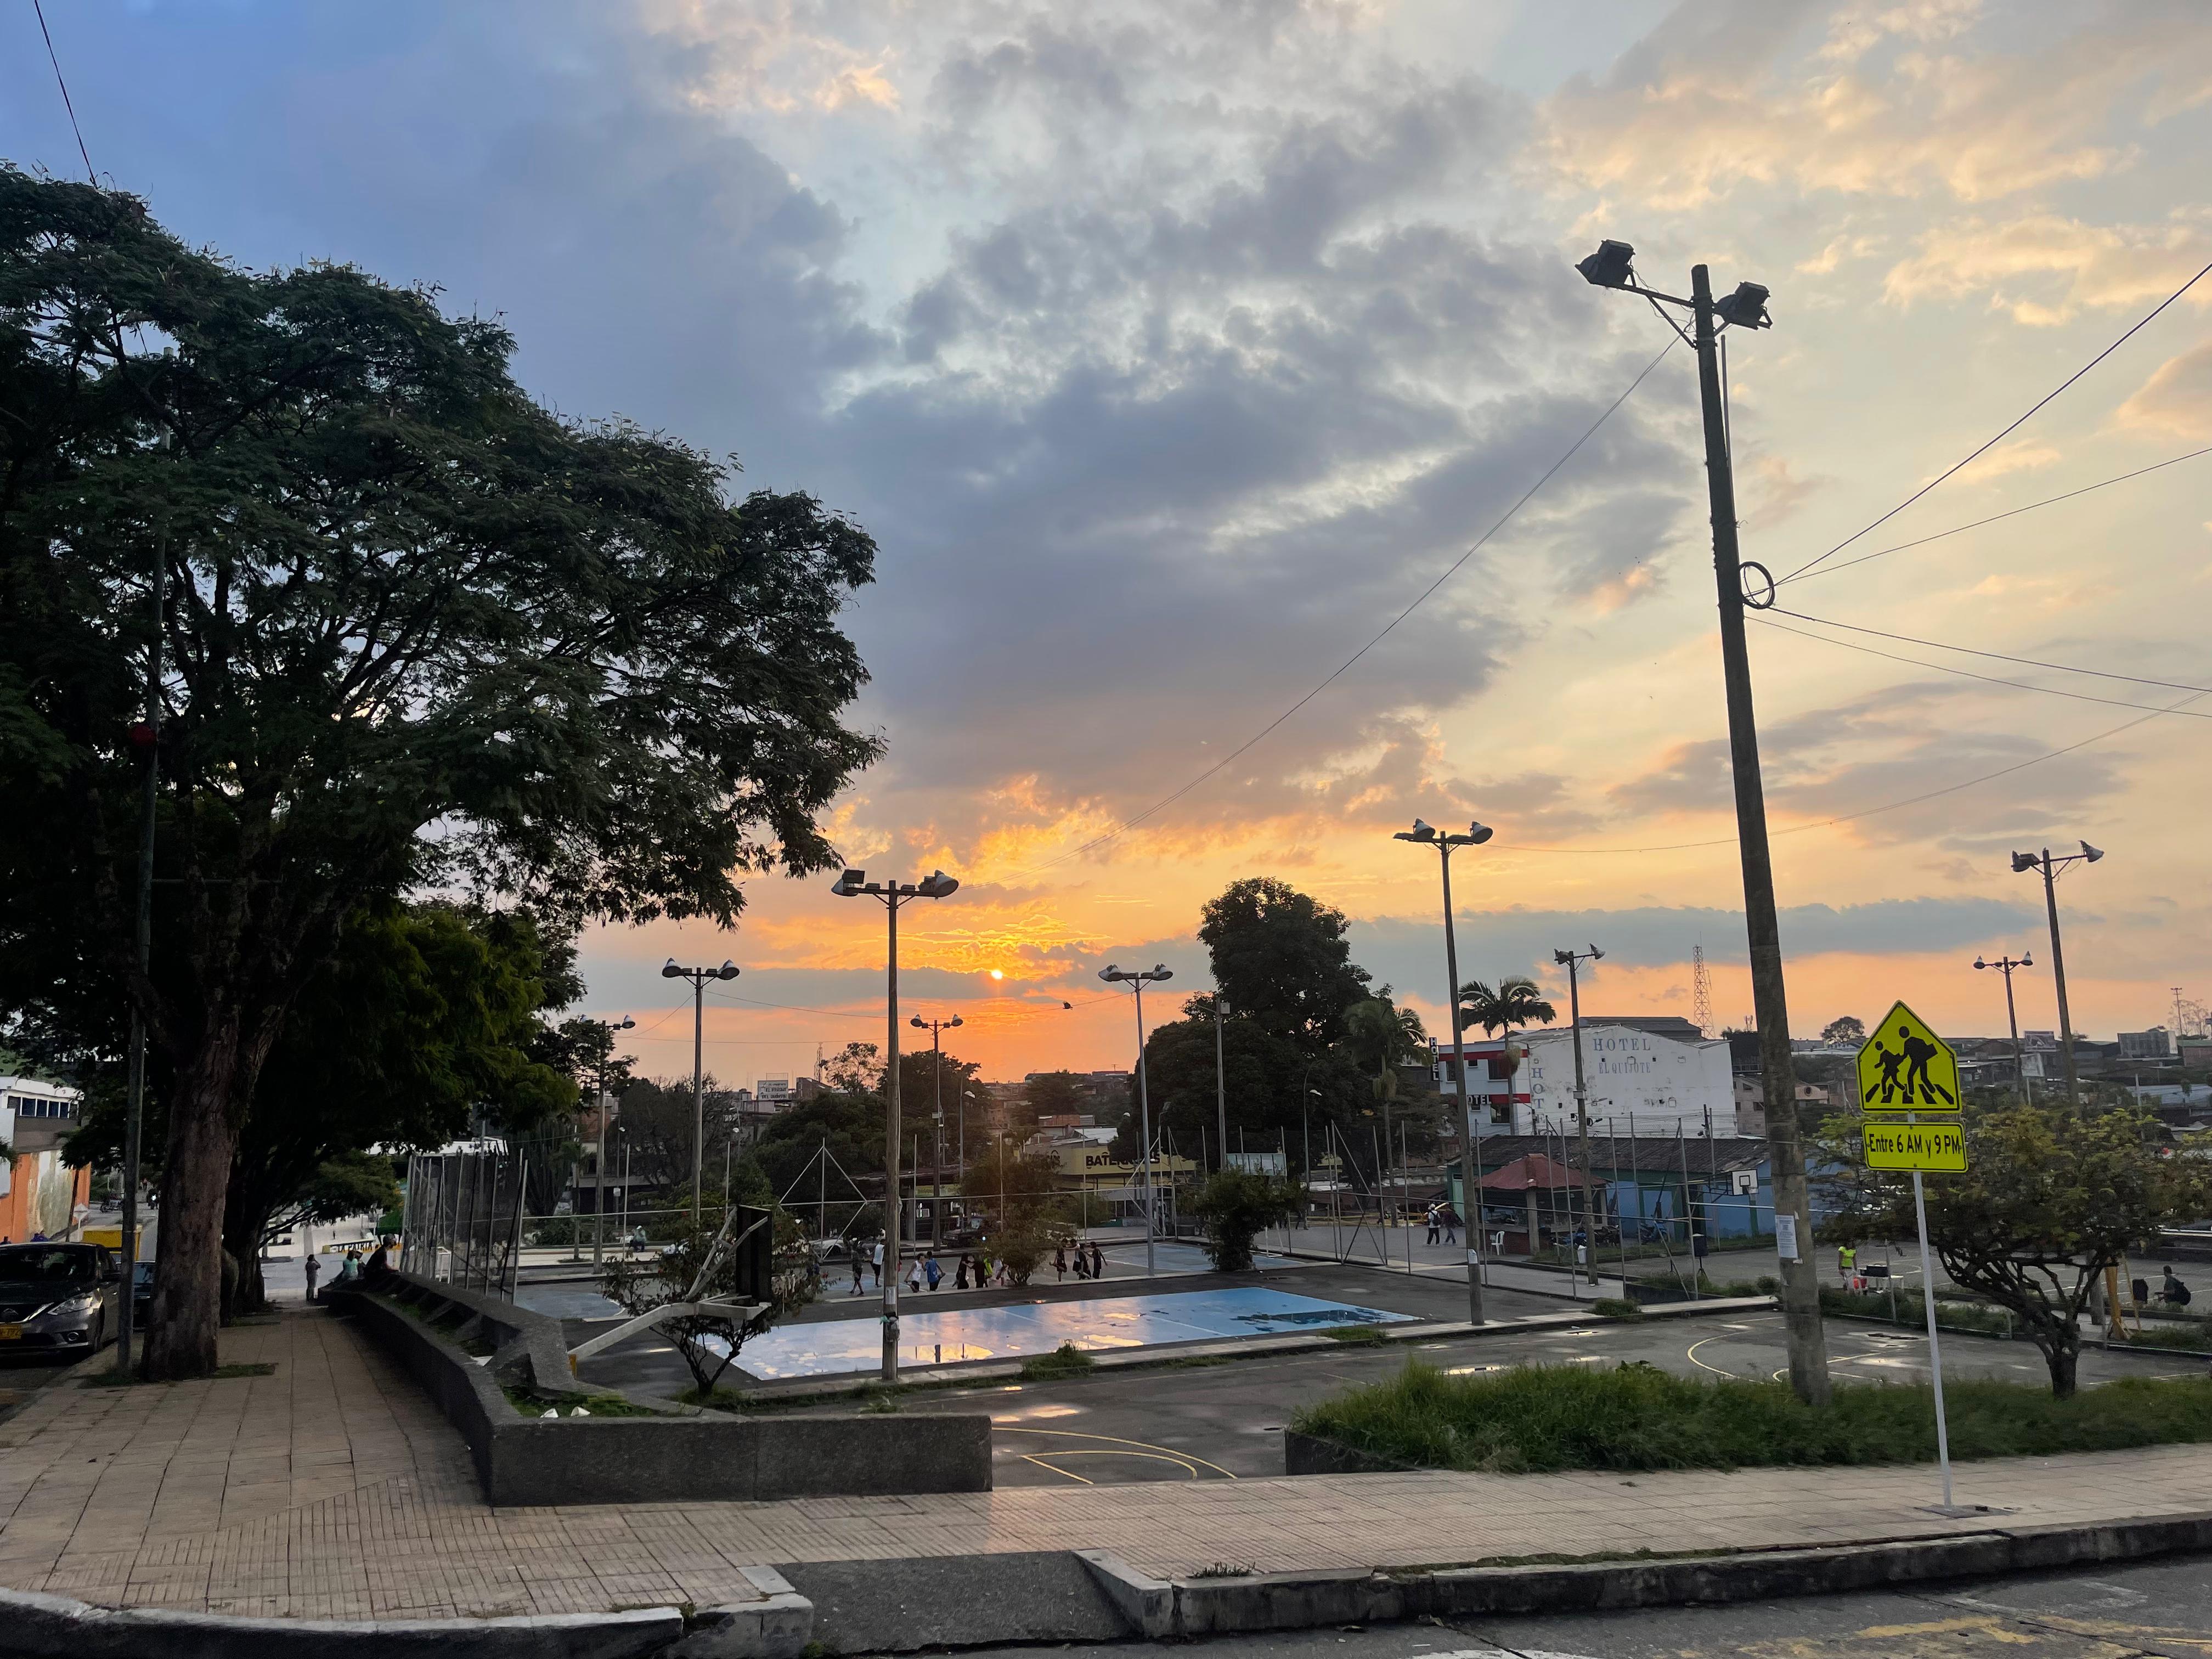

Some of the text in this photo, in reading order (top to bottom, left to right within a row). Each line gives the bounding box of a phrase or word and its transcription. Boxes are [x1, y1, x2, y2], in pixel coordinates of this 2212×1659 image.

[1593, 1039, 1651, 1051] HOTEL
[1430, 1037, 1439, 1081] HOTEL
[1599, 1062, 1651, 1074] EL QUIJOTE
[1466, 1094, 1492, 1104] OTEL
[1869, 1133, 1961, 1159] Entre 6 AM y 9 PM
